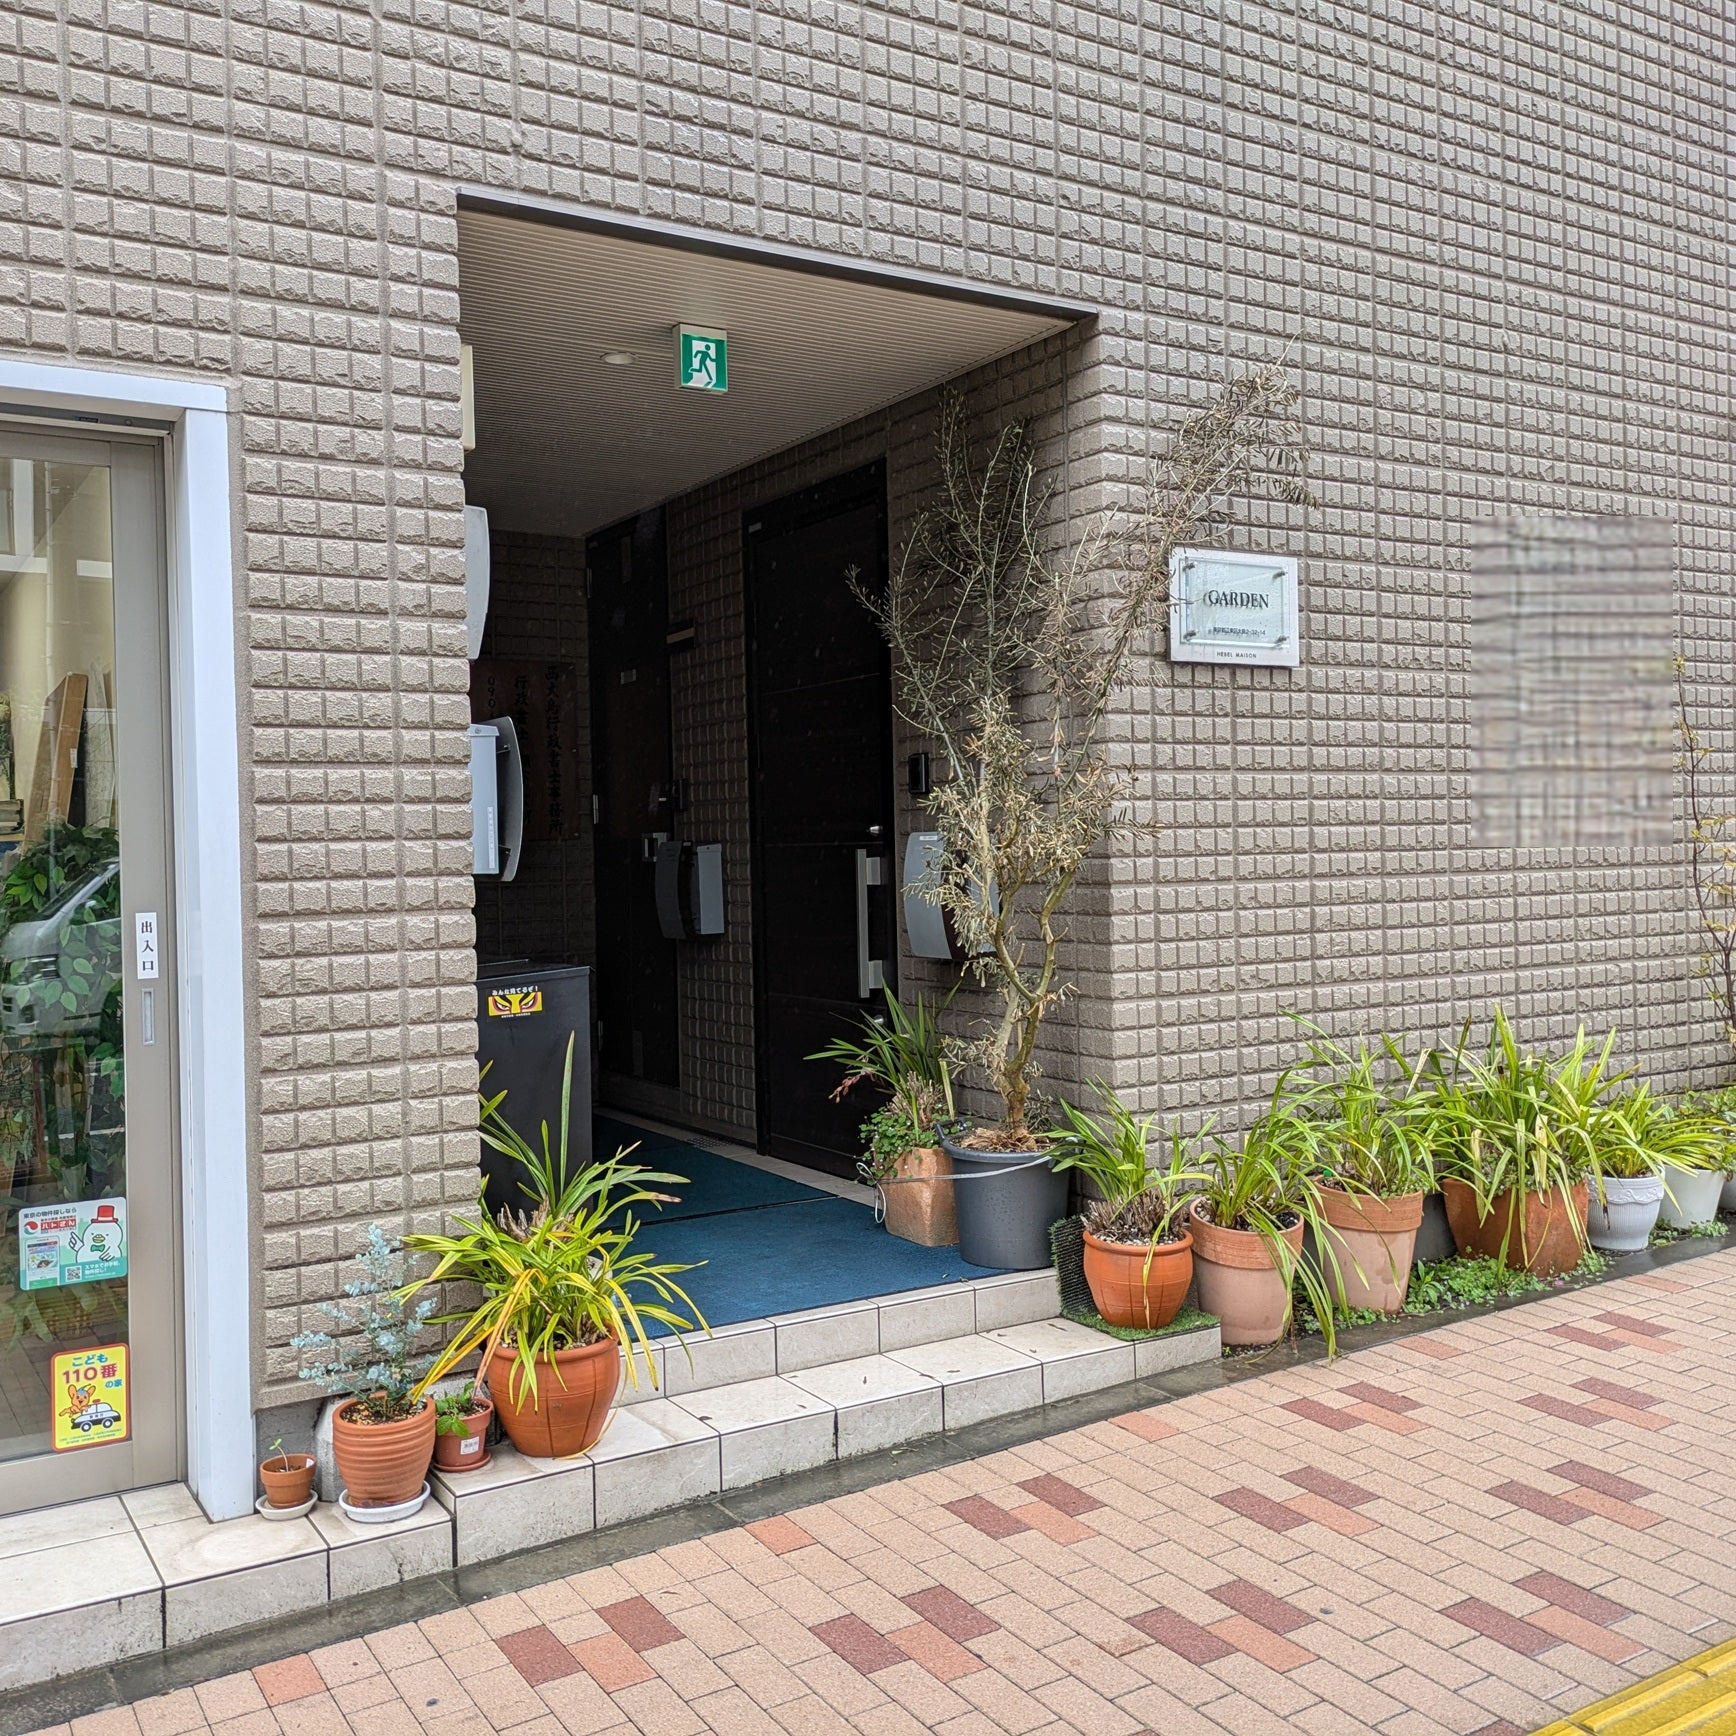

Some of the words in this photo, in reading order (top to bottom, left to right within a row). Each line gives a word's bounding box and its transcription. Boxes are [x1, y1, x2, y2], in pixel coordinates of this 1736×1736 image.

[1208, 589, 1269, 608] GARDEN
[544, 666, 565, 835] 西大島行政書士事務所
[141, 921, 154, 971] 出入口
[23, 1207, 77, 1219] 東京の物件探しなら
[42, 1220, 75, 1229] ハトさん
[72, 1353, 108, 1367] こども
[62, 1363, 117, 1384] 110番
[105, 1379, 122, 1388] の家
